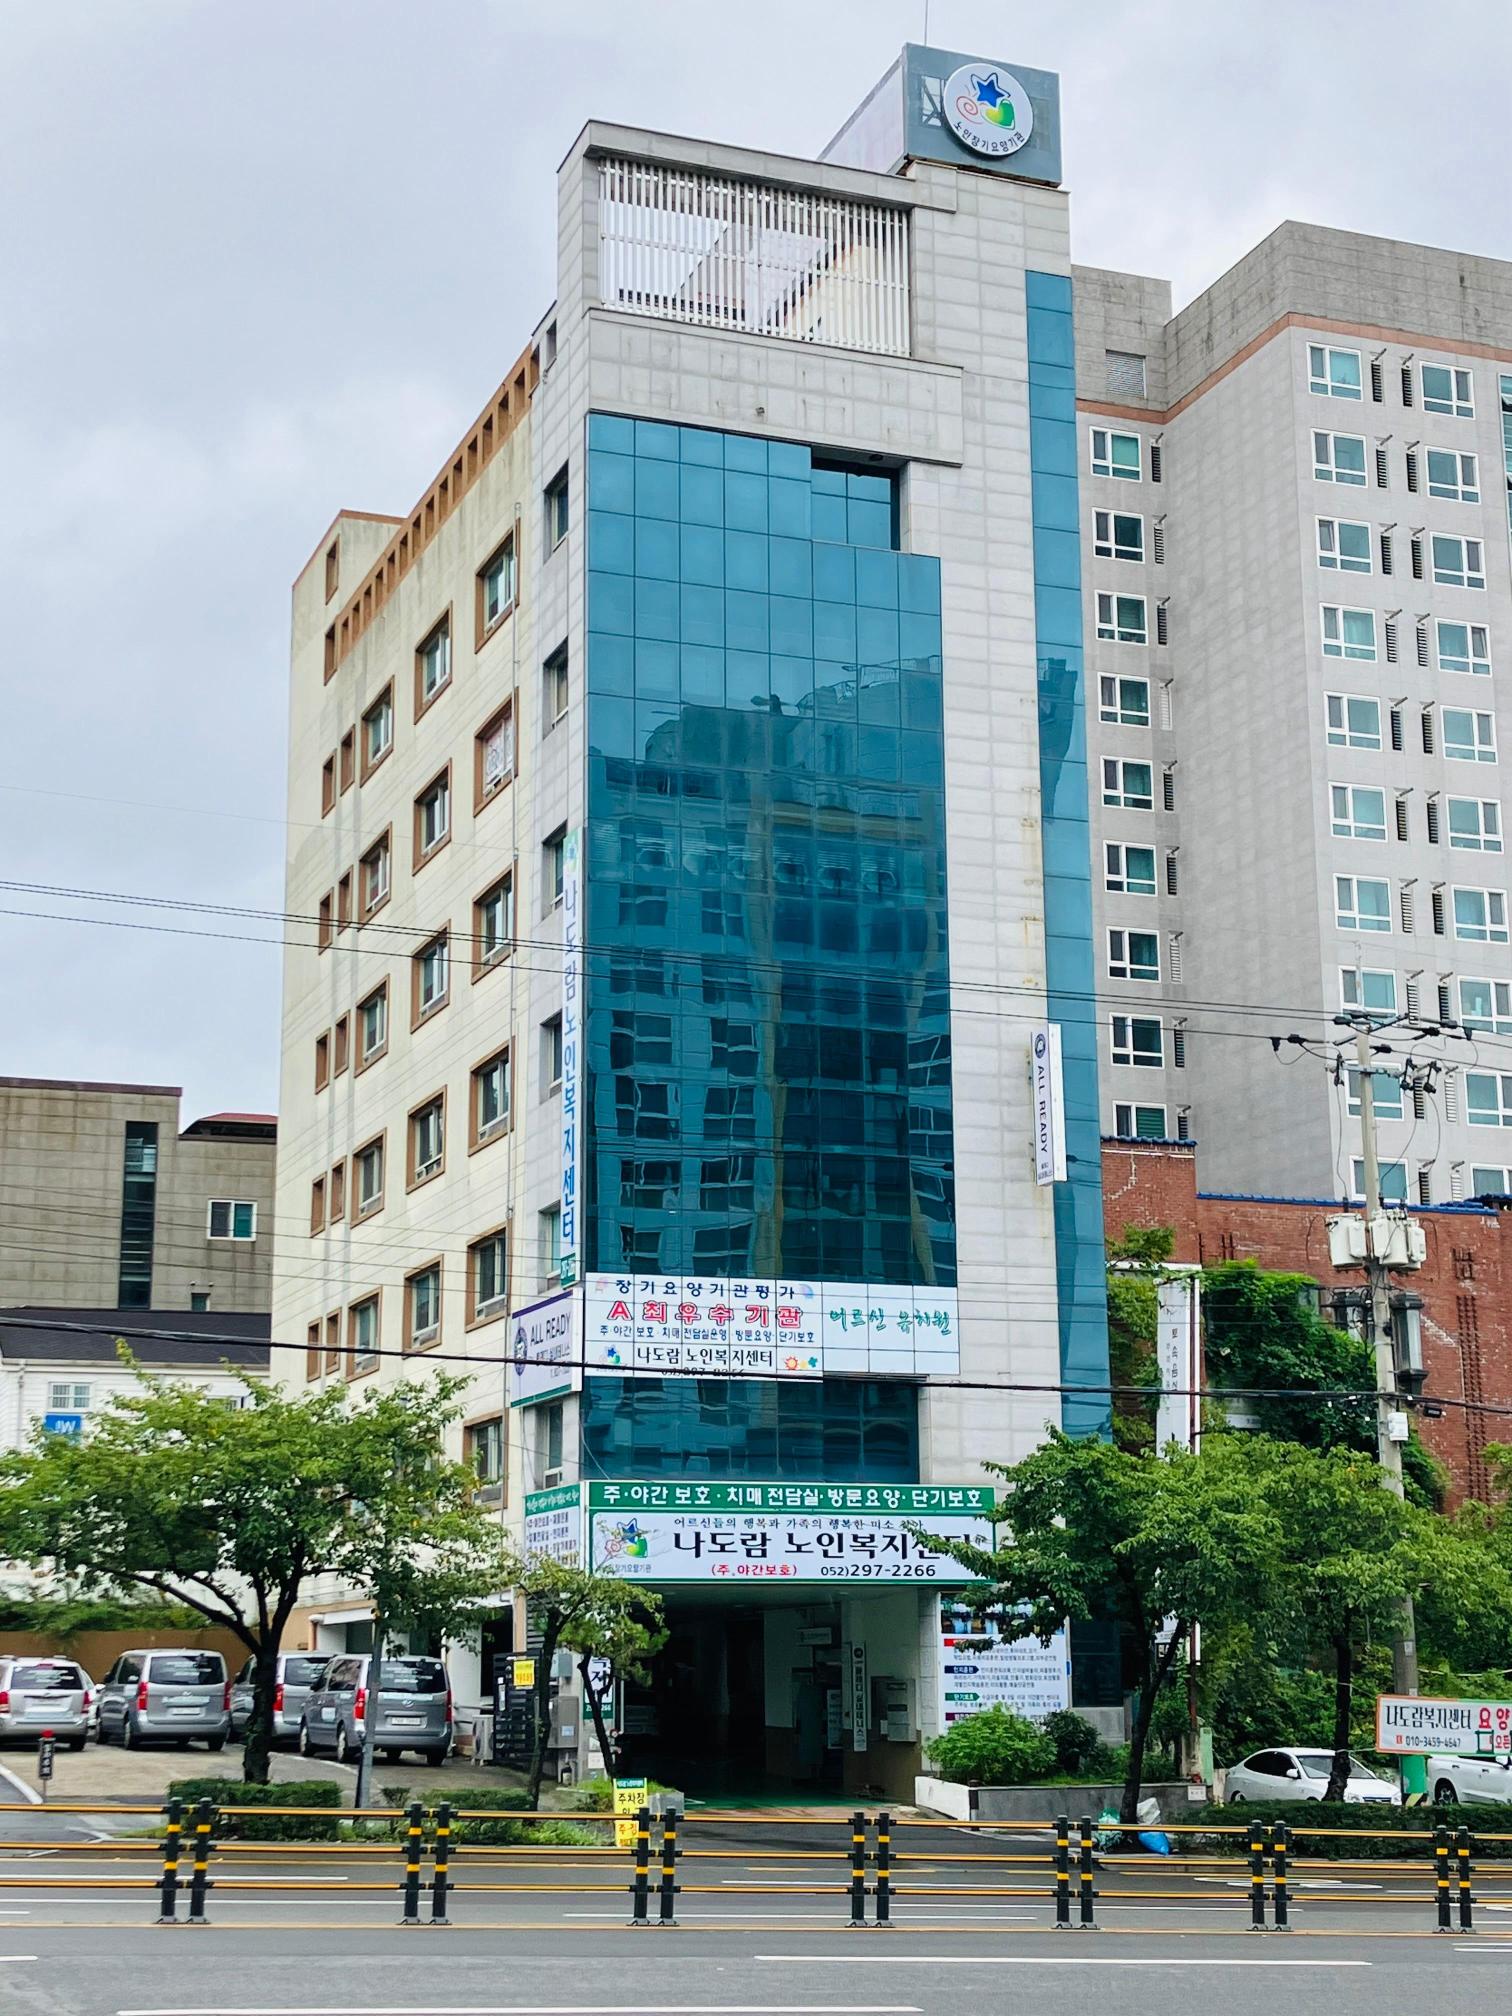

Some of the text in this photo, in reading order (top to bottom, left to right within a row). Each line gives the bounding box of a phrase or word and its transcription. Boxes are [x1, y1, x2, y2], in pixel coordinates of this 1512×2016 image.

[954, 121, 1025, 152] 노인장기요양기관
[1039, 1100, 1048, 1153] READY
[530, 1311, 571, 1346] ALL READY
[637, 1347, 773, 1367] 나도람 노인복지센터
[675, 1486, 711, 1505] 보호
[727, 1487, 762, 1506] 치매
[912, 1489, 982, 1508] 단기보호
[674, 1517, 736, 1528] 어르신들의
[744, 1517, 780, 1529] 행복과
[786, 1518, 822, 1529] 가족의
[829, 1519, 864, 1530] 행복한
[871, 1519, 894, 1530] 미소
[673, 1531, 772, 1559] 나도람
[820, 1564, 936, 1577] 052)297-2266
[1386, 1705, 1471, 1729] 나도람복지센터
